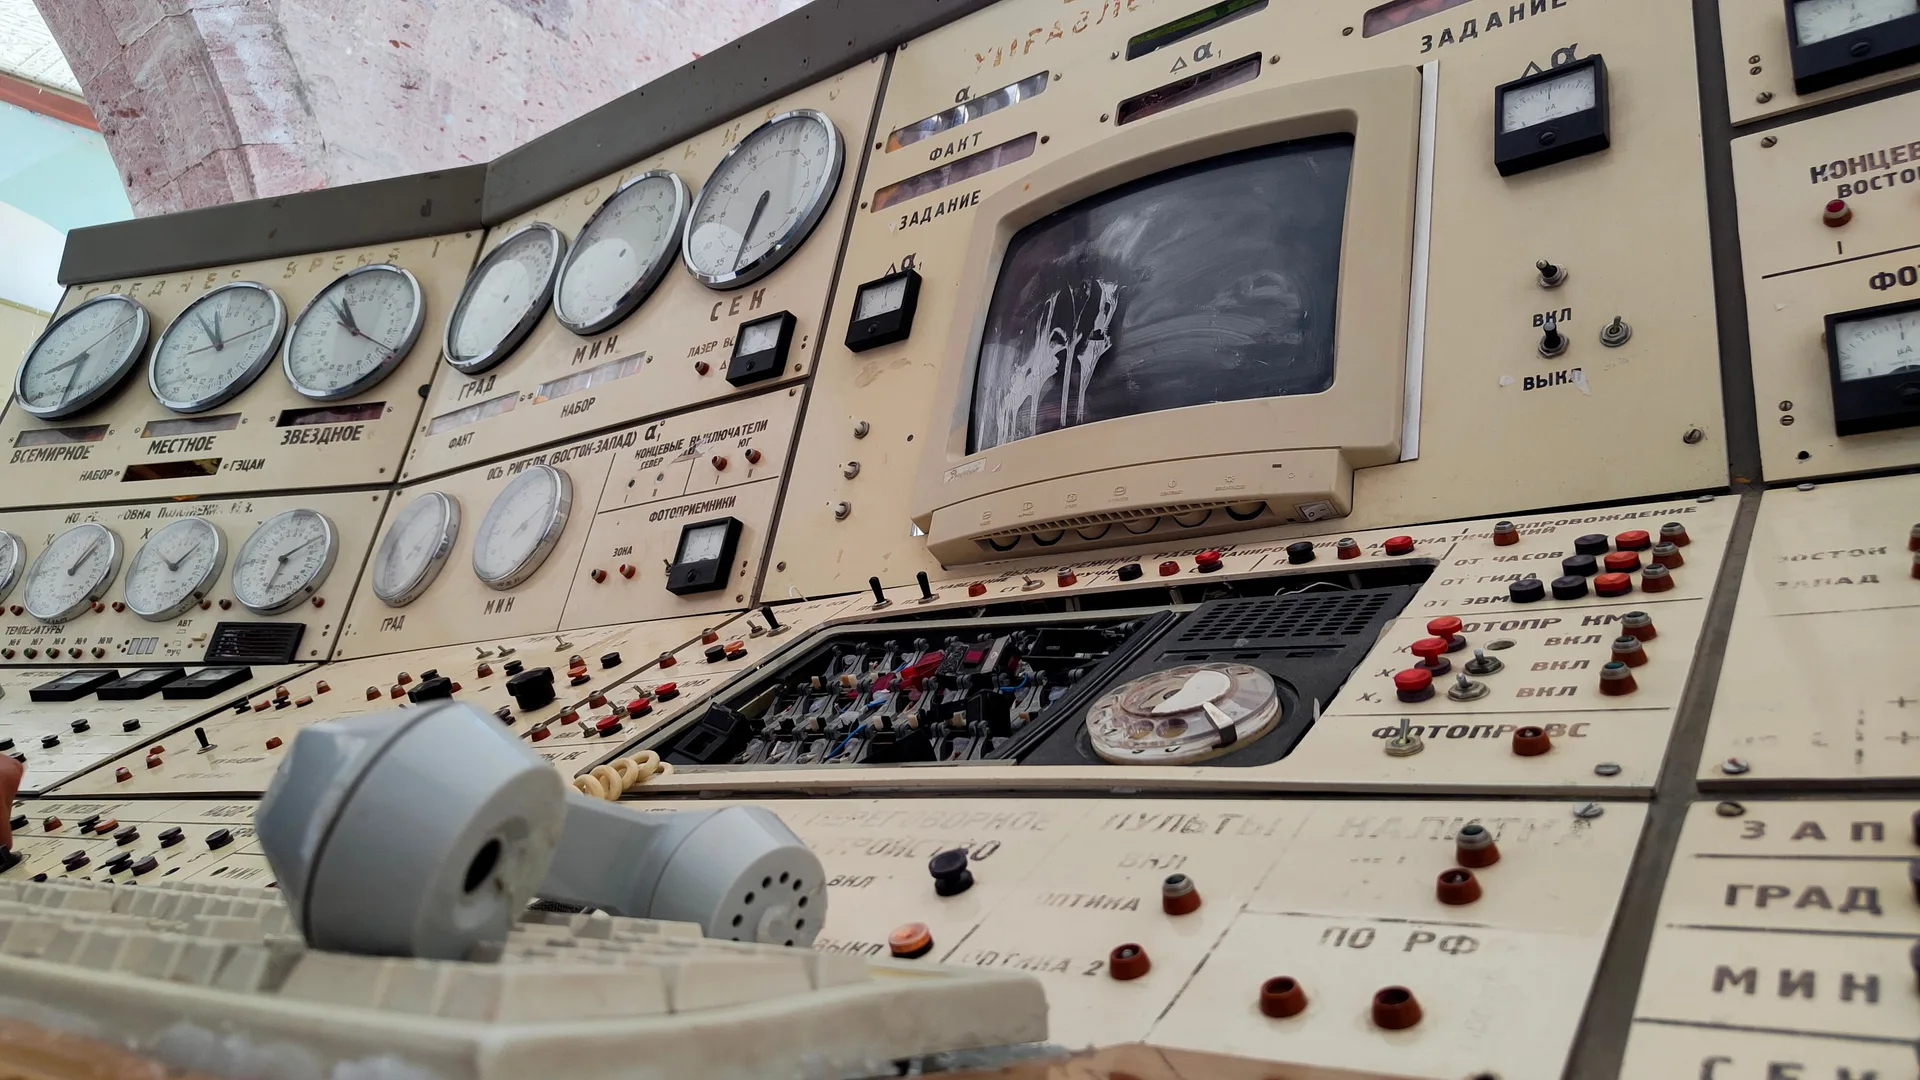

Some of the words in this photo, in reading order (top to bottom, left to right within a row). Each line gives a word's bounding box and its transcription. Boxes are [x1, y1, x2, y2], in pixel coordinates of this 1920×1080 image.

[929, 131, 982, 161] ФАКТ
[1837, 167, 1920, 199] ВОСТО
[899, 189, 982, 231] ЗАДАНИЕ
[1869, 265, 1920, 291] ФО
[710, 287, 766, 321] СЕК
[1532, 307, 1572, 328] ВКЛ
[572, 334, 618, 366] МИН
[687, 340, 718, 358] ЛАЗЕР
[458, 374, 497, 401] ГРАД
[561, 397, 596, 418] НАБОР
[280, 425, 364, 445] ЗВЕЗДНОЕ
[448, 432, 475, 449] ФАКТ
[737, 437, 752, 448] ЮГ
[10, 445, 94, 464] ВСЕМИРНОЕ
[147, 436, 217, 455] МЕСТНОЕ
[635, 438, 685, 459] КОНЦЕВЫЕ
[640, 457, 664, 470] СЕВЕР
[79, 469, 113, 482] НАБОР
[487, 467, 504, 481] ОСЬ
[649, 496, 737, 522] ФОТОПРИЕМНИКИ
[1513, 506, 1698, 530] ОПРОВОЖДЕНИЕ
[1366, 526, 1557, 550] АОМАТИЧКИЙ
[612, 546, 633, 557] ЗОНА
[1454, 557, 1484, 566] ОТ
[1492, 551, 1564, 563] ЧАСОВ
[1440, 577, 1469, 586] ОТ
[1477, 572, 1538, 584] ГИДА
[484, 597, 515, 615] МИН
[1423, 599, 1452, 608] ОТ
[1461, 595, 1510, 606] ЭВМ
[5, 625, 66, 635] ТЕМПЕРАТУРЫ
[177, 619, 193, 627] АВТ
[380, 615, 406, 632] ГРАД
[1462, 617, 1563, 633] ОТОПР
[1544, 634, 1602, 647] ВКЛ
[1530, 659, 1591, 672] ВКЛ
[1515, 686, 1578, 698] ВКЛ
[1544, 722, 1591, 738] ВС
[1740, 820, 1884, 841] ЗАП
[828, 875, 877, 888] ВКЛ
[1724, 884, 1883, 916] ГРАД
[813, 938, 885, 956] ВЫКЛ
[1320, 926, 1377, 949] ПО
[1402, 930, 1481, 955] РФ
[1082, 960, 1105, 976] 2
[1711, 964, 1880, 1004] МИН
